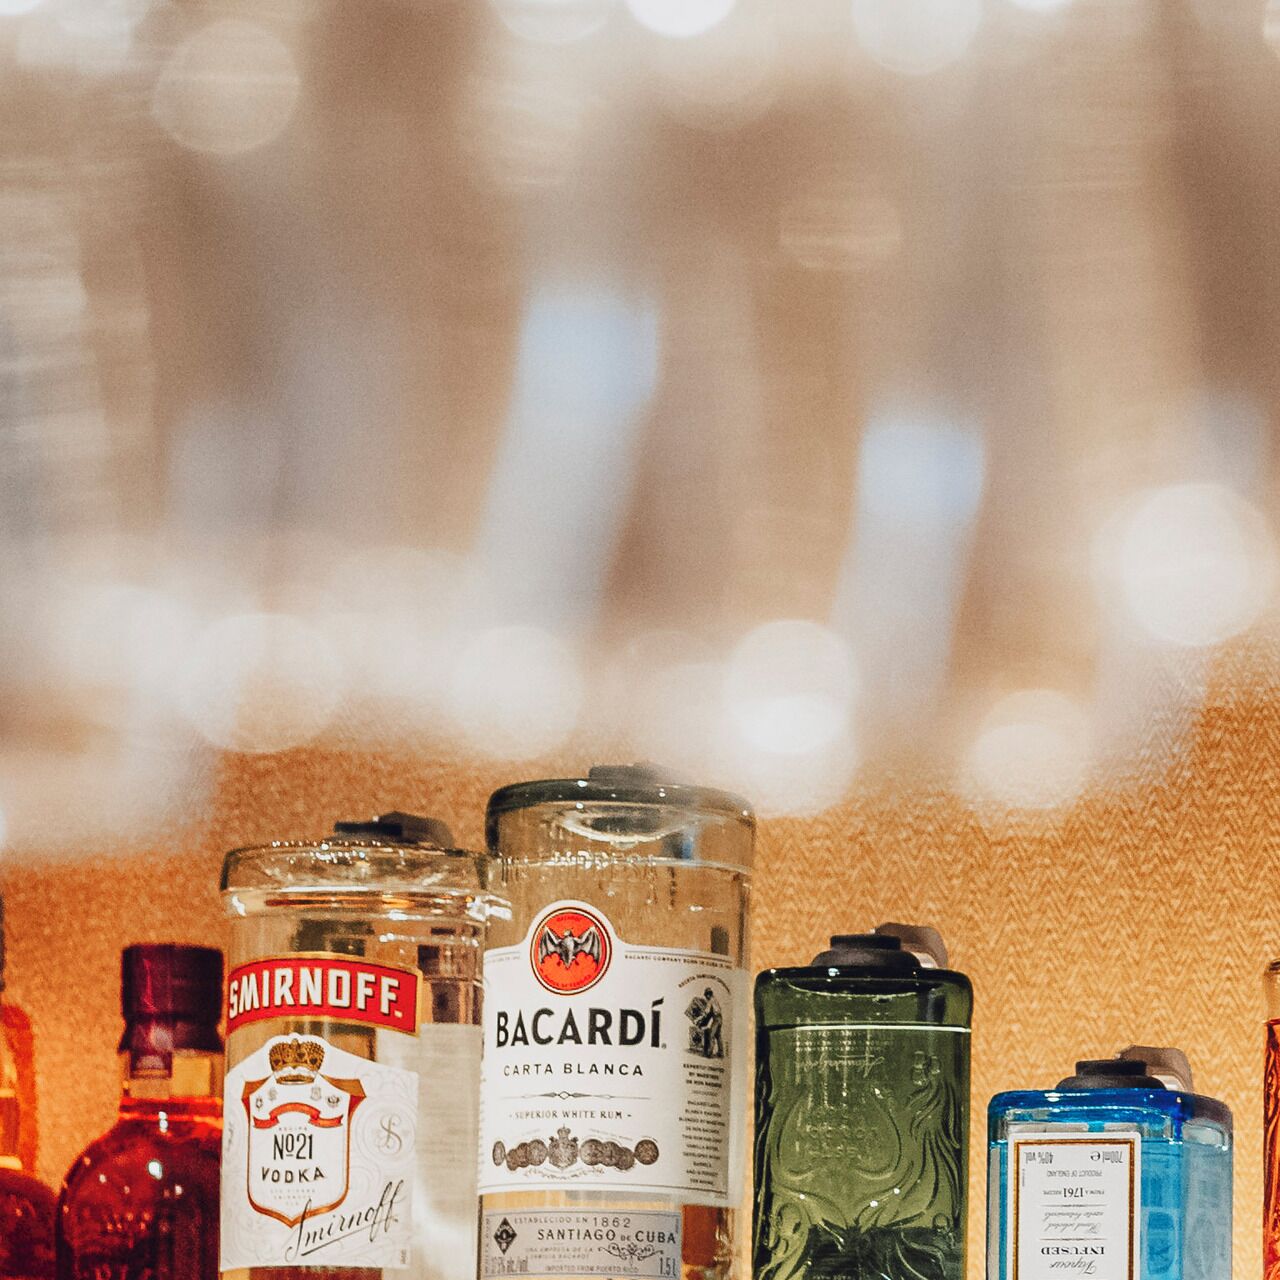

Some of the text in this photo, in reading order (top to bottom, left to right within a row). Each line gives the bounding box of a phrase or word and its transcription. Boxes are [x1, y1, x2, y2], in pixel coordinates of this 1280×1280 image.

[497, 996, 665, 1049] BACARDÍ
[504, 1063, 643, 1077] CARTA BLANCA
[515, 1110, 622, 1120] SUPERIOR WHITE RUM
[261, 1167, 325, 1184] VODKA
[1046, 1169, 1103, 1178] PRODUCT OF ENGLAND
[1063, 1187, 1083, 1198] 1761
[284, 1179, 405, 1262] Smirnoff
[593, 1217, 631, 1228] 1862
[538, 1229, 616, 1241] SANTIAGO
[635, 1230, 676, 1244] CUBA
[1040, 1246, 1105, 1255] INFUSED
[1050, 1256, 1097, 1275] Vapour
